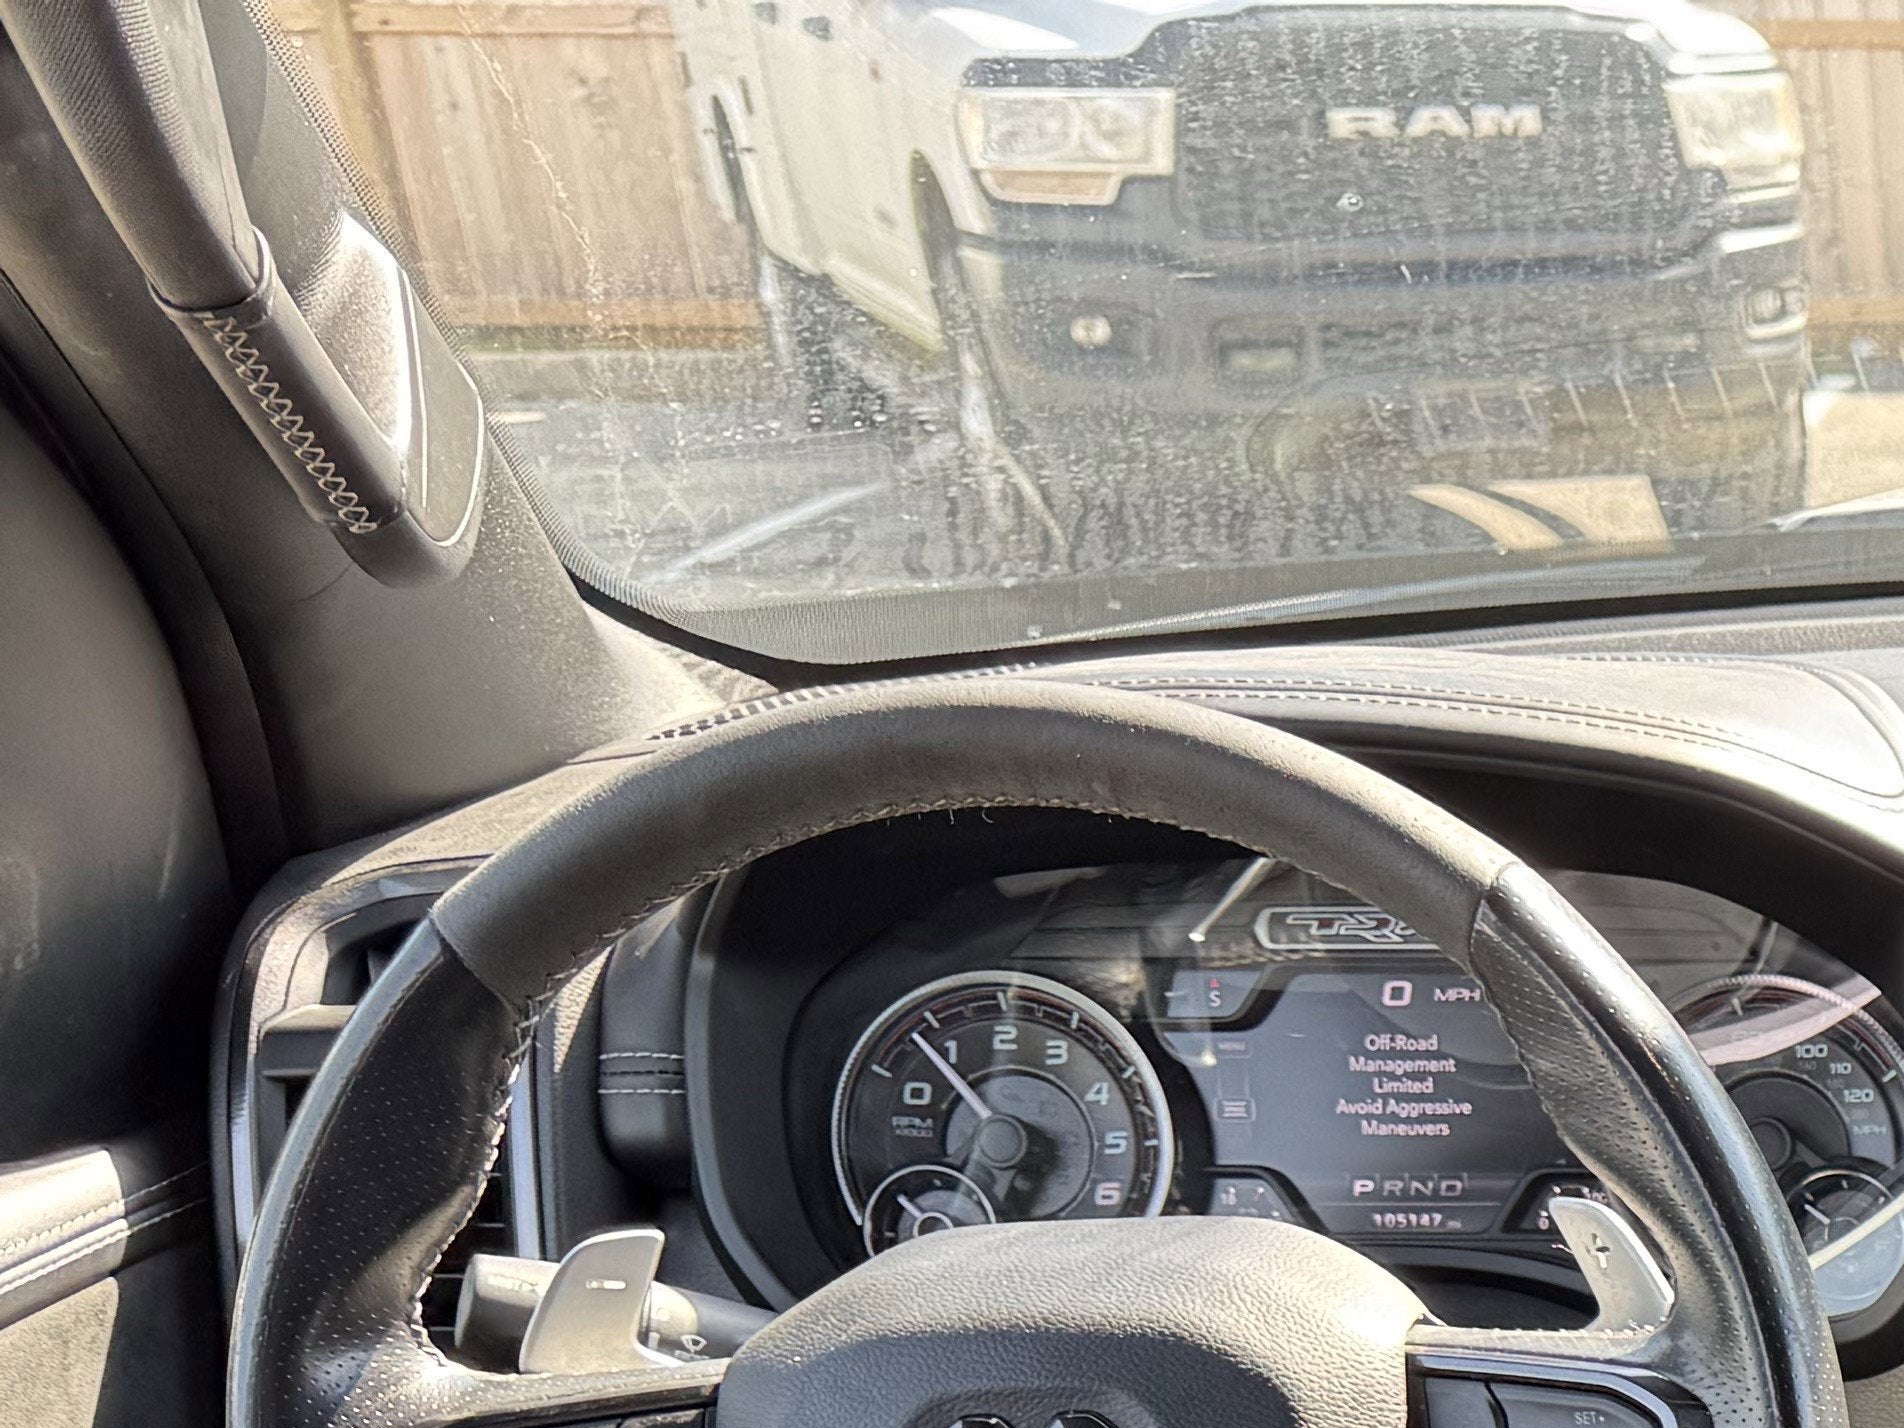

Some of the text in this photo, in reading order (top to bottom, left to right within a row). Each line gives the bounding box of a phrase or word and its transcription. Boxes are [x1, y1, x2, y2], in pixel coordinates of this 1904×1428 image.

[1326, 104, 1542, 138] RAM
[1382, 980, 1480, 1006] 0 MPH
[993, 1025, 1018, 1051] 2
[1364, 1034, 1438, 1051] Off-Road
[944, 1040, 957, 1064] 1
[1045, 1040, 1068, 1065] 3
[1795, 1044, 1828, 1058] 100
[1349, 1057, 1457, 1076] Management
[1829, 1063, 1852, 1075] 110
[903, 1082, 932, 1105] 0
[1084, 1082, 1110, 1105] 4
[1373, 1077, 1434, 1094] Limited
[1843, 1089, 1874, 1103] 120
[1336, 1099, 1473, 1116] Avoid Aggressive
[1361, 1119, 1451, 1137] Maneuvers
[1104, 1132, 1128, 1155] 5
[1095, 1183, 1121, 1205] 6
[1353, 1180, 1463, 1197] P R N D
